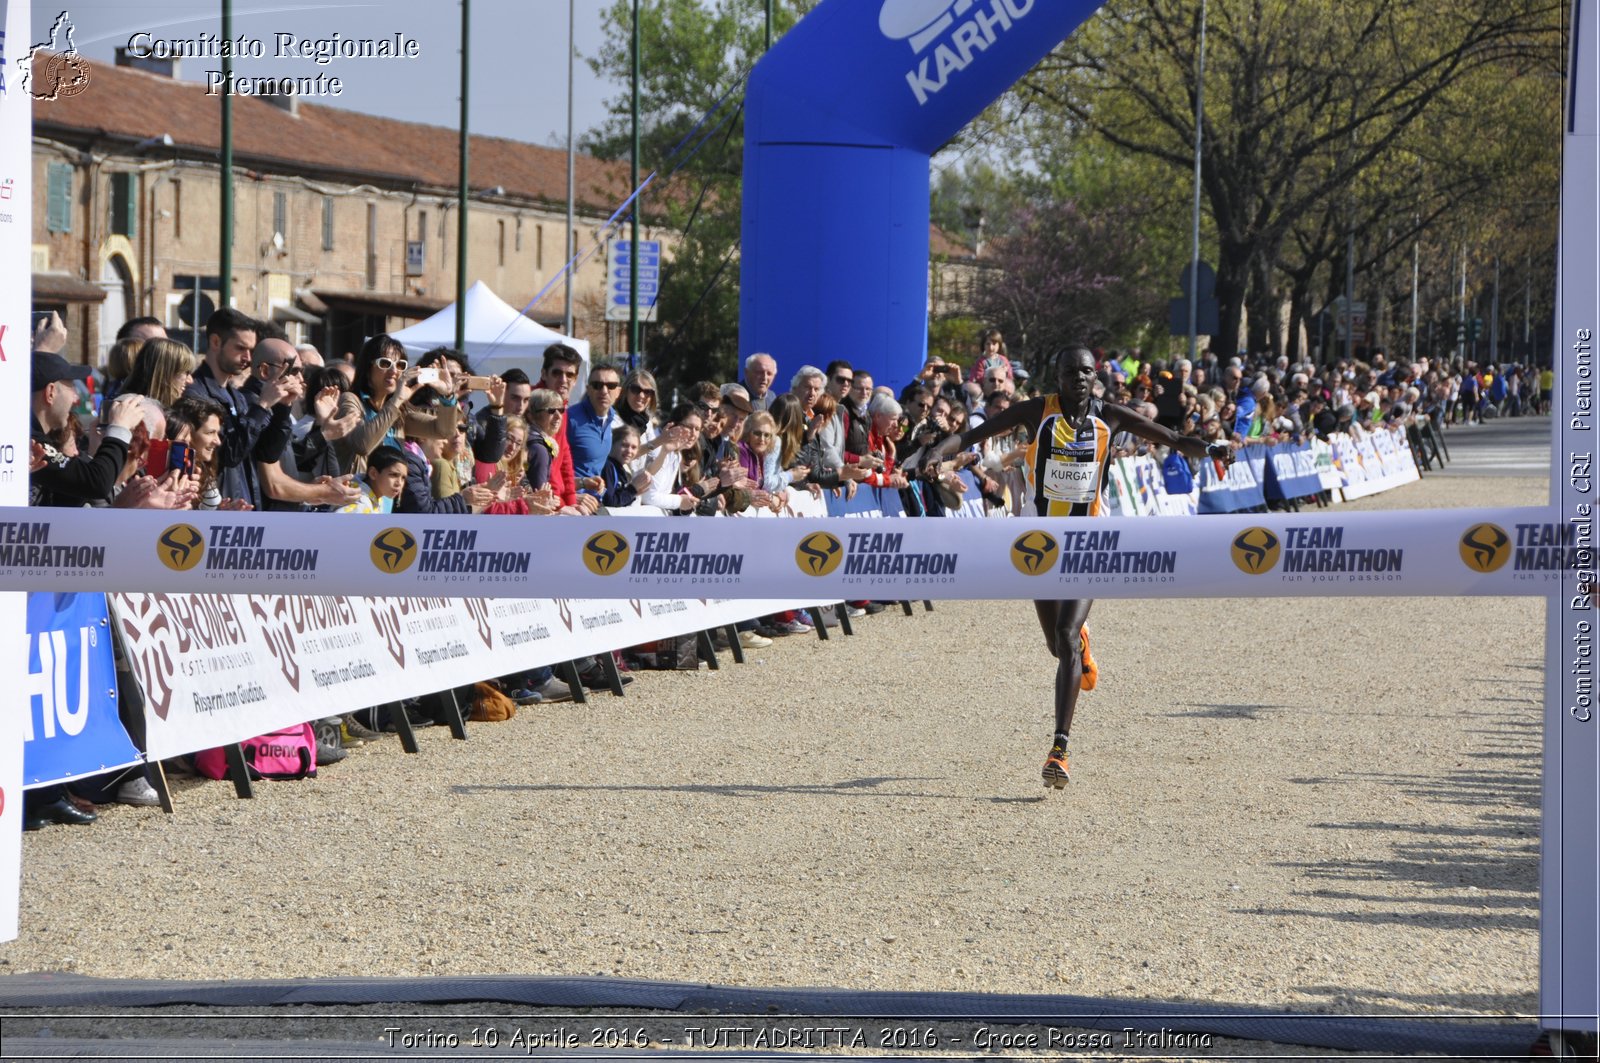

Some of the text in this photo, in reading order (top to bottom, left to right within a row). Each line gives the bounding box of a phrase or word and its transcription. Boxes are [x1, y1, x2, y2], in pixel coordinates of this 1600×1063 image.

[905, 0, 1035, 106] KARHU
[1051, 469, 1093, 480] KURGAT
[210, 526, 264, 547] TEAM
[423, 530, 477, 551] TEAM
[635, 532, 689, 553] TEAM
[848, 533, 903, 553] TEAM
[1063, 530, 1120, 551] TEAM
[1285, 527, 1344, 548] TEAM
[1515, 523, 1576, 546] TEAM
[206, 548, 318, 571] MARATHON
[418, 552, 531, 573] MARATHON
[630, 554, 743, 575] MARATHON
[844, 554, 957, 575] MARATHON
[1060, 551, 1176, 574] MARATHON
[1282, 549, 1403, 572] MARATHON
[56, 569, 104, 577] passion
[870, 577, 897, 585] your
[1088, 576, 1115, 584] your
[1124, 576, 1175, 584] passion
[1350, 574, 1402, 582] passion
[193, 687, 228, 717] Risparmi
[226, 691, 240, 708] con
